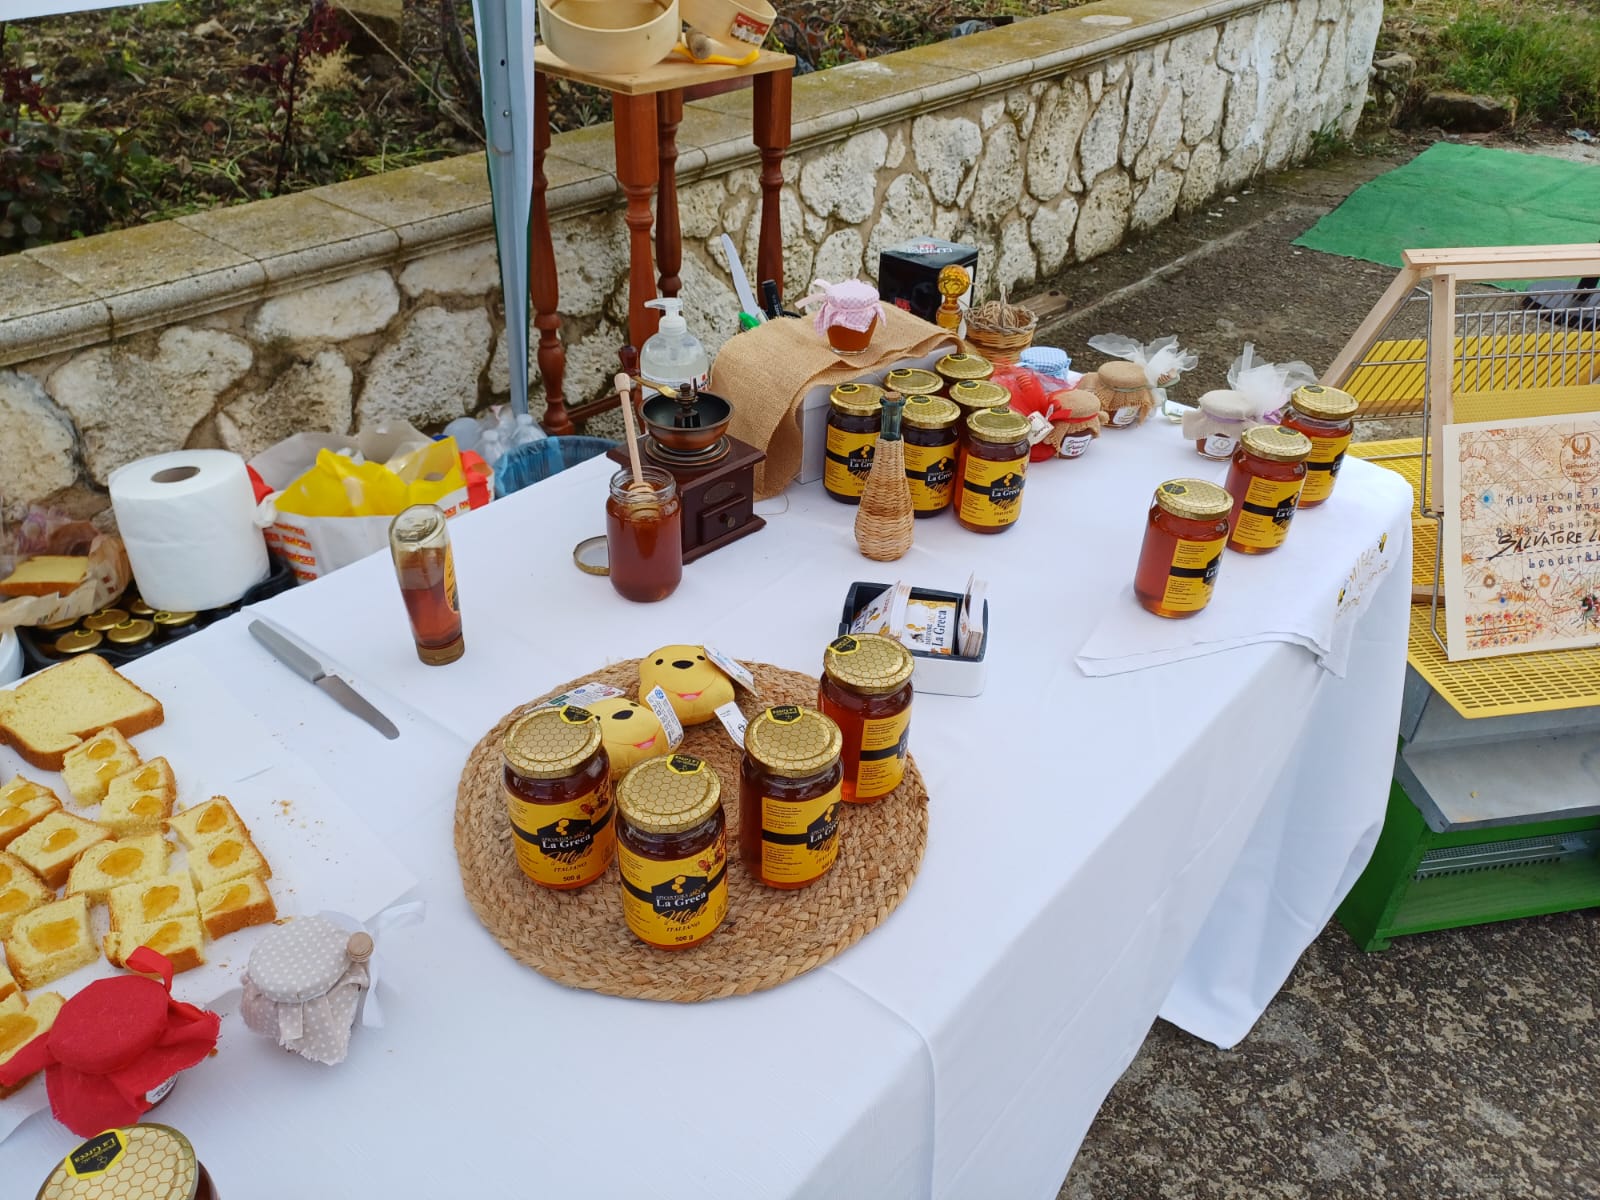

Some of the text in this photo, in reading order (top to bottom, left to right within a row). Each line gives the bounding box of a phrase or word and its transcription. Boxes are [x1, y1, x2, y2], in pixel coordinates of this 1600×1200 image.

[1488, 530, 1582, 560] SALVATORE
[542, 833, 591, 849] La Greca
[656, 891, 706, 908] La Greca
